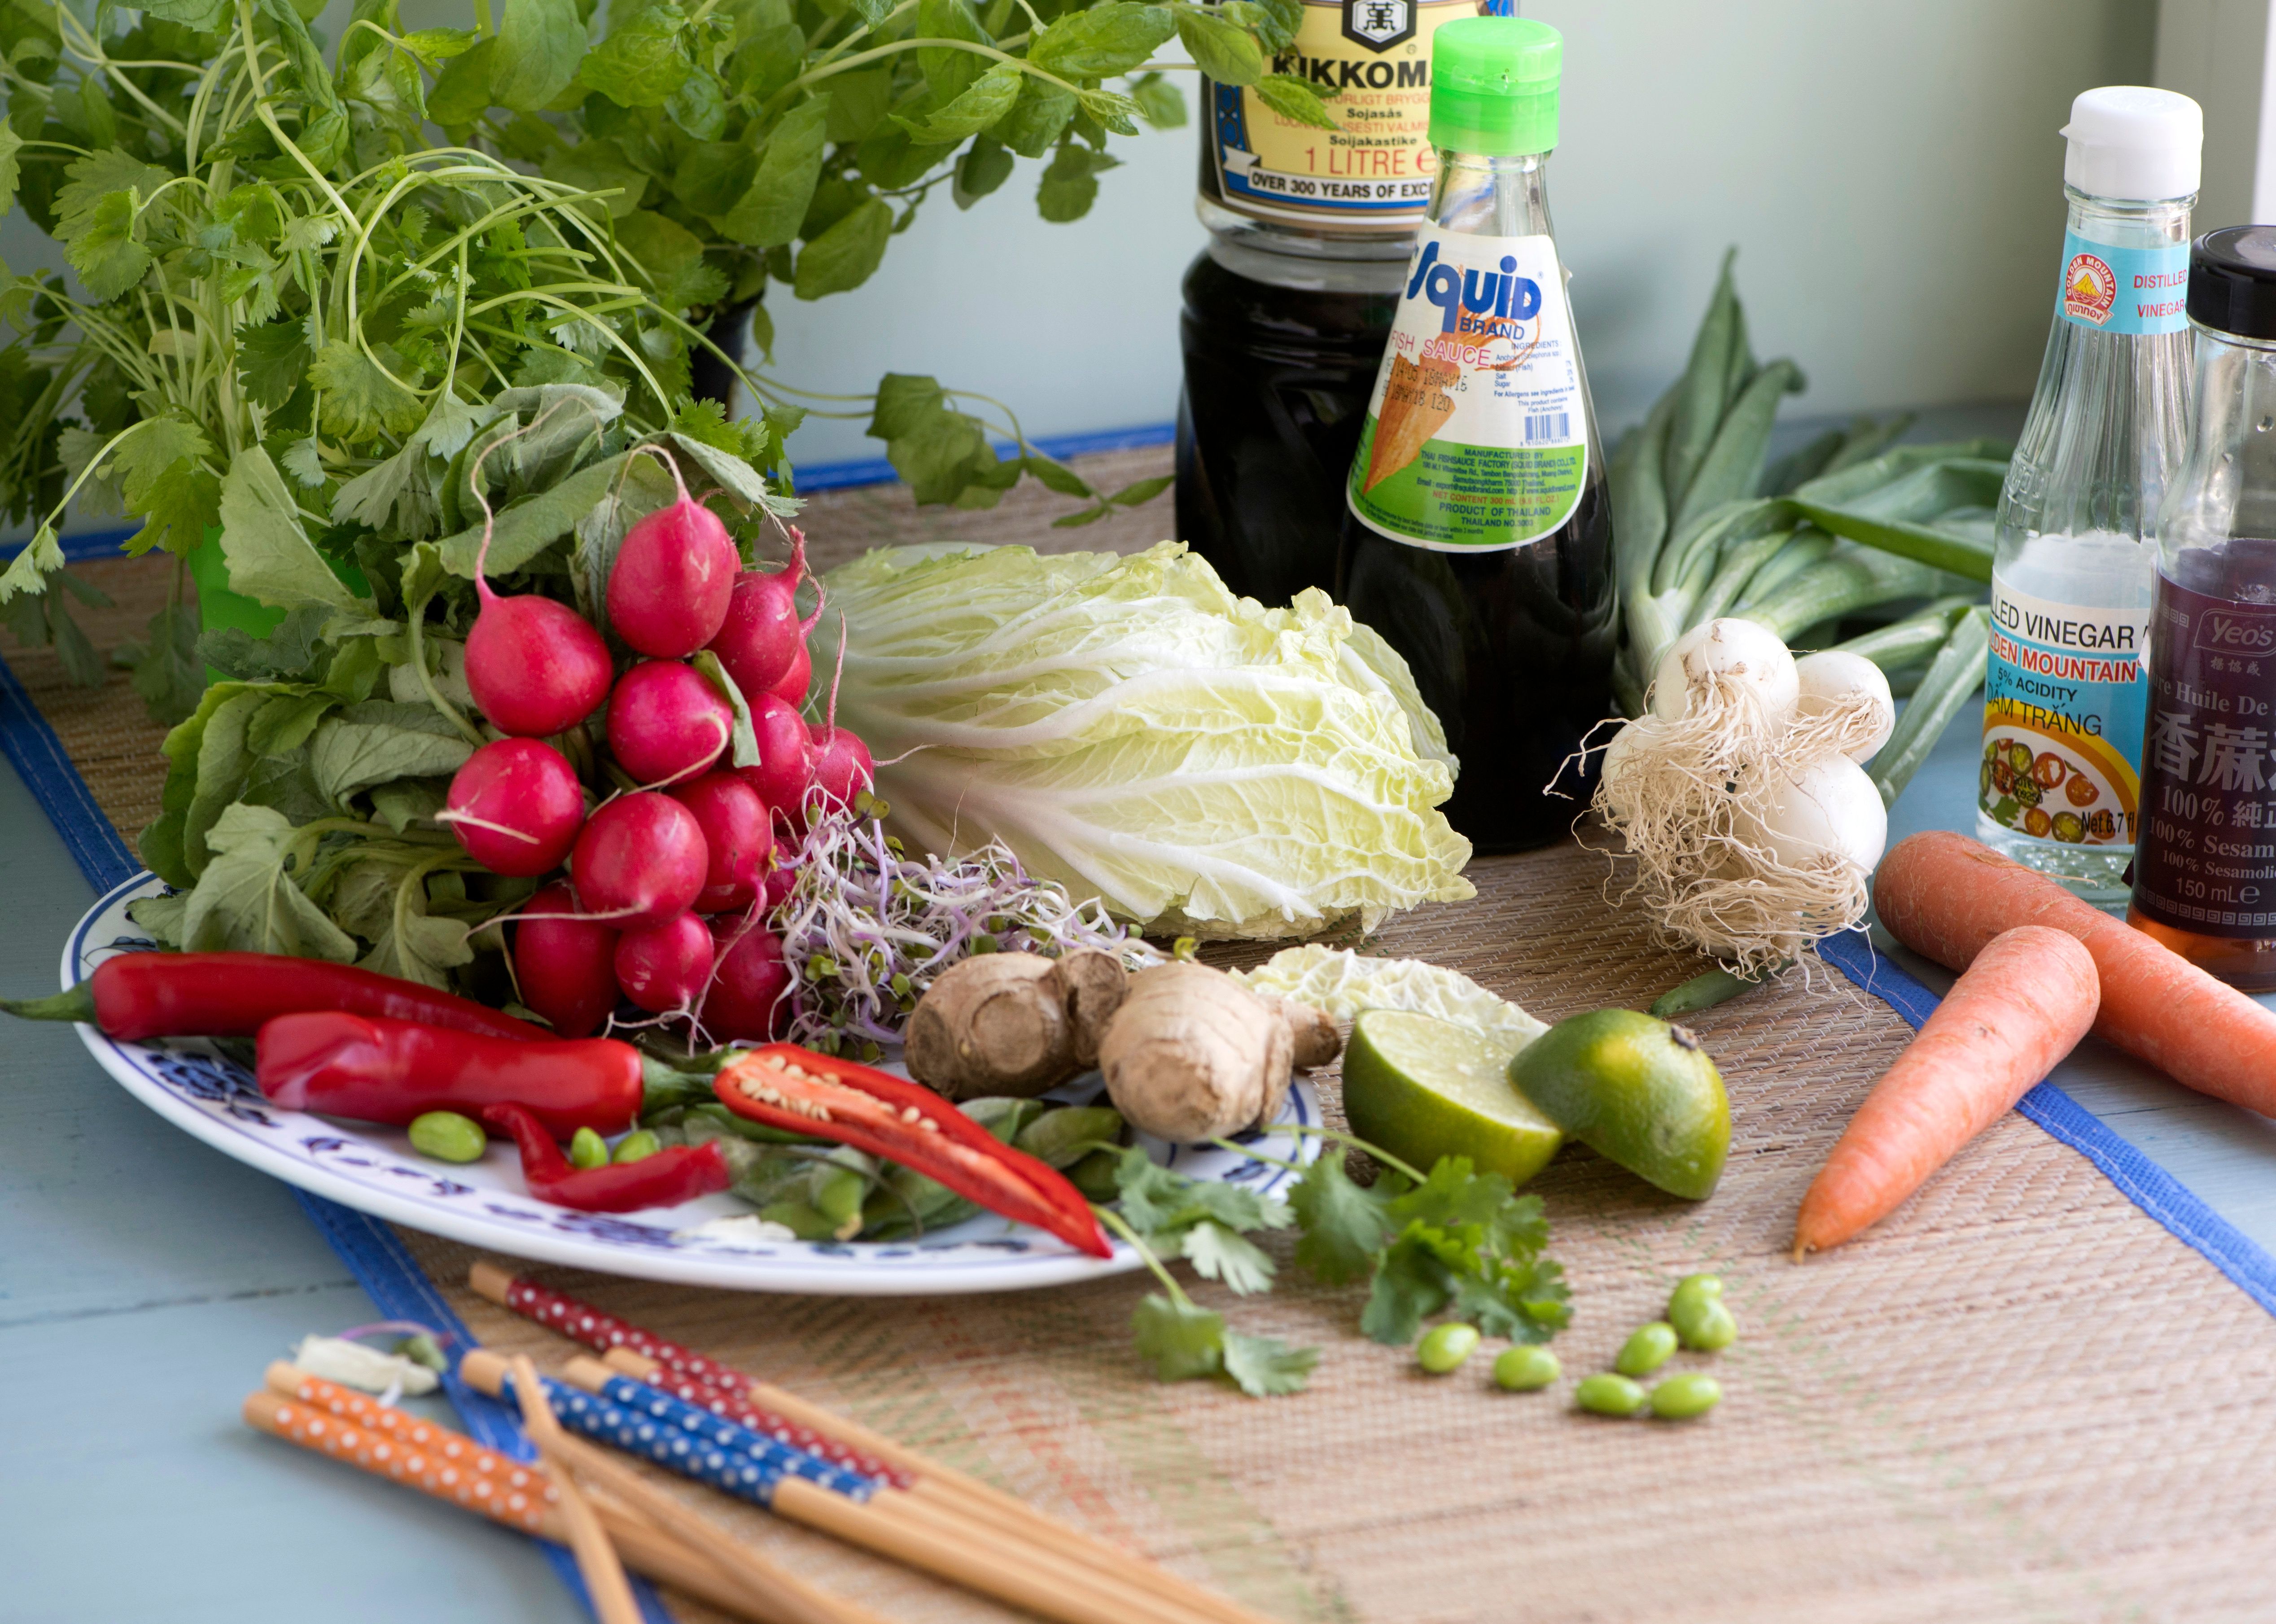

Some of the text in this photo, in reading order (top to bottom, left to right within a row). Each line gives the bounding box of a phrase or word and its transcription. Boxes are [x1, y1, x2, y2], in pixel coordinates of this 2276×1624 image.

[1273, 55, 1432, 89] KIKKOM
[1305, 146, 1315, 172] 1
[1329, 148, 1406, 175] LITRE
[1252, 172, 1286, 191] OVER
[1291, 180, 1315, 195] 300
[1321, 183, 1370, 198] YEARS
[1376, 184, 1395, 198] OF
[2066, 256, 2114, 308] GOLDEN MOUNTAIN
[2134, 269, 2188, 289] DISTILLED
[2137, 298, 2184, 318] VINEGAR
[1459, 317, 1525, 340] BRAND
[1392, 330, 1491, 367] FISH SAUCE
[1464, 448, 1530, 460] MANUFACTURED
[1478, 459, 1510, 469] FACTORY
[1439, 502, 1551, 517] PRODUCT OF THAILAND
[1450, 493, 1488, 504] CONTENT
[1461, 517, 1502, 527] THAILAND
[2025, 611, 2135, 649] VINEGAR
[2211, 616, 2274, 647] Yeo's
[2022, 647, 2137, 682] MOUNTAIN
[1998, 666, 2078, 702] 5% ACIDITY
[2175, 680, 2231, 712] Huile
[2237, 695, 2268, 716] De
[2081, 811, 2103, 833] Net
[2176, 877, 2206, 899] 150
